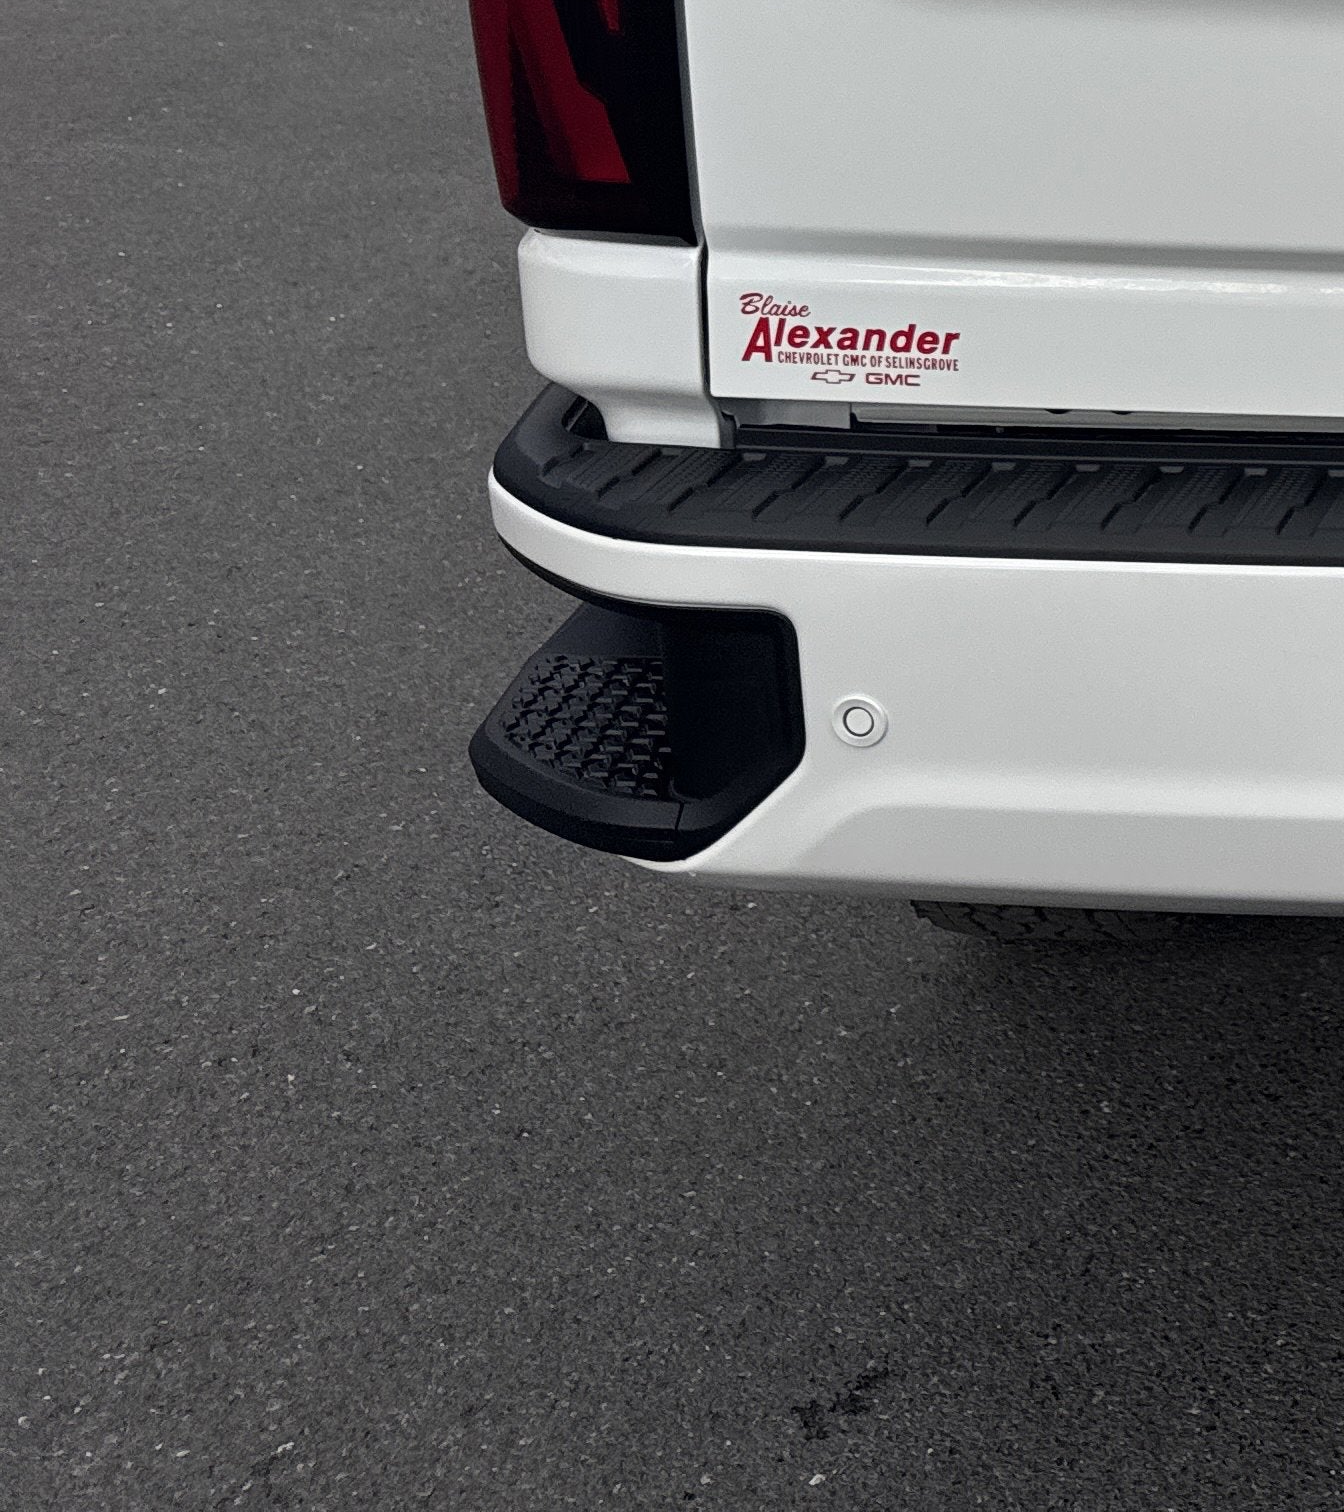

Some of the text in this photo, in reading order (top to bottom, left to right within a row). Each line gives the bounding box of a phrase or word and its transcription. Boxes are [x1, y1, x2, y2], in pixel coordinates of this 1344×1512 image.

[740, 292, 811, 318] Blaise
[741, 316, 960, 363] Alexander
[777, 351, 959, 372] CHEVROLET GMC OF SELINSGROVE
[865, 372, 921, 387] GMC
